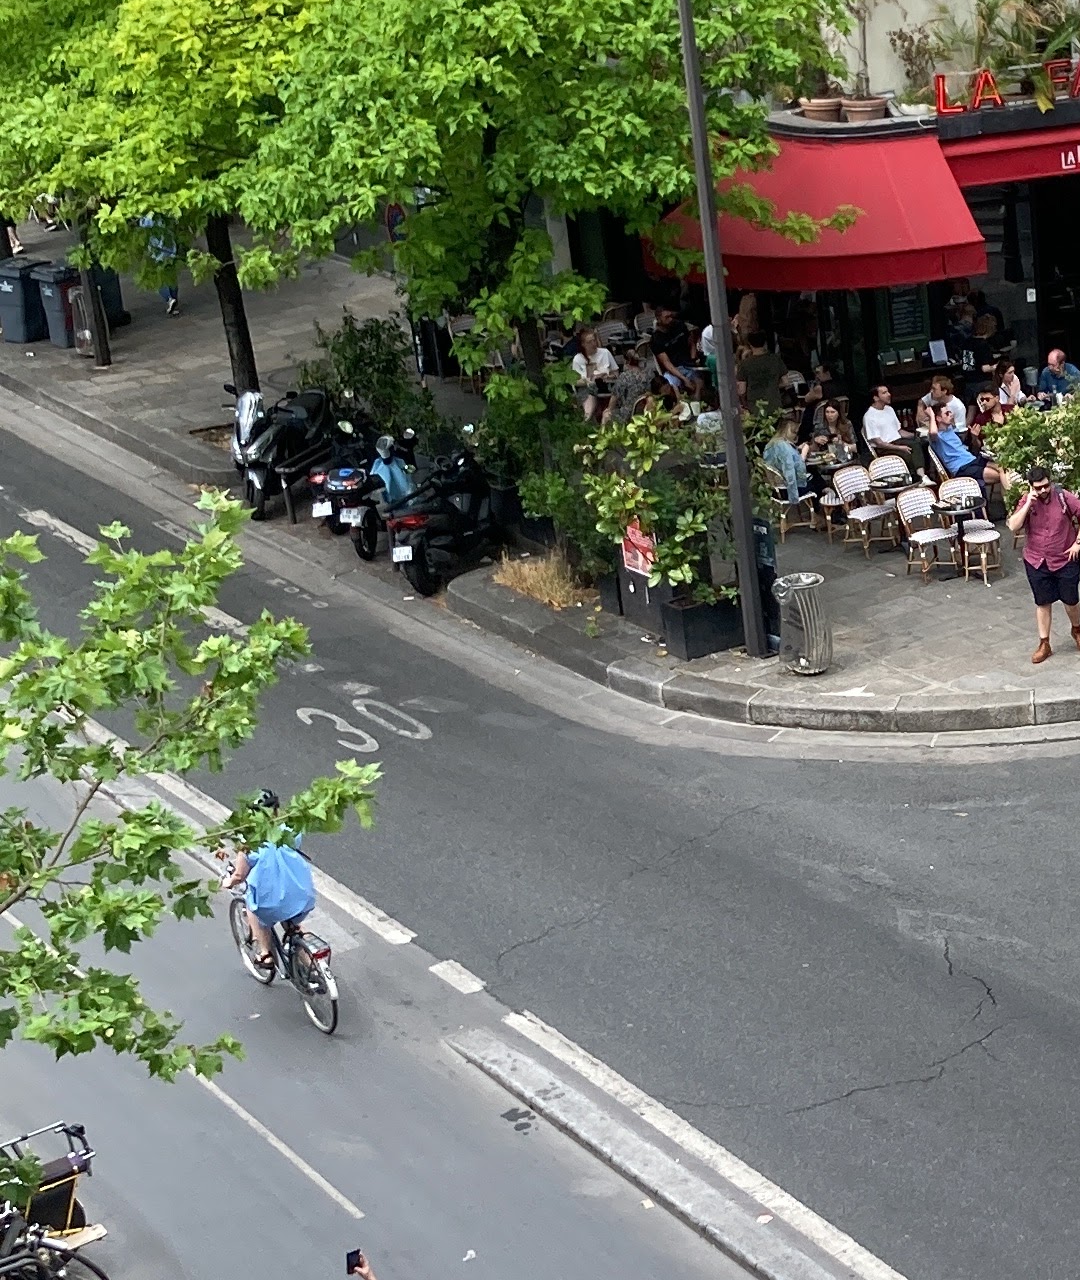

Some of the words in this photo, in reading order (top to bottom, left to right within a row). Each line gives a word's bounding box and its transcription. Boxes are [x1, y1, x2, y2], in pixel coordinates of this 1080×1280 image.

[934, 70, 1006, 116] LA
[1061, 151, 1076, 169] LA
[296, 698, 433, 753] 30
